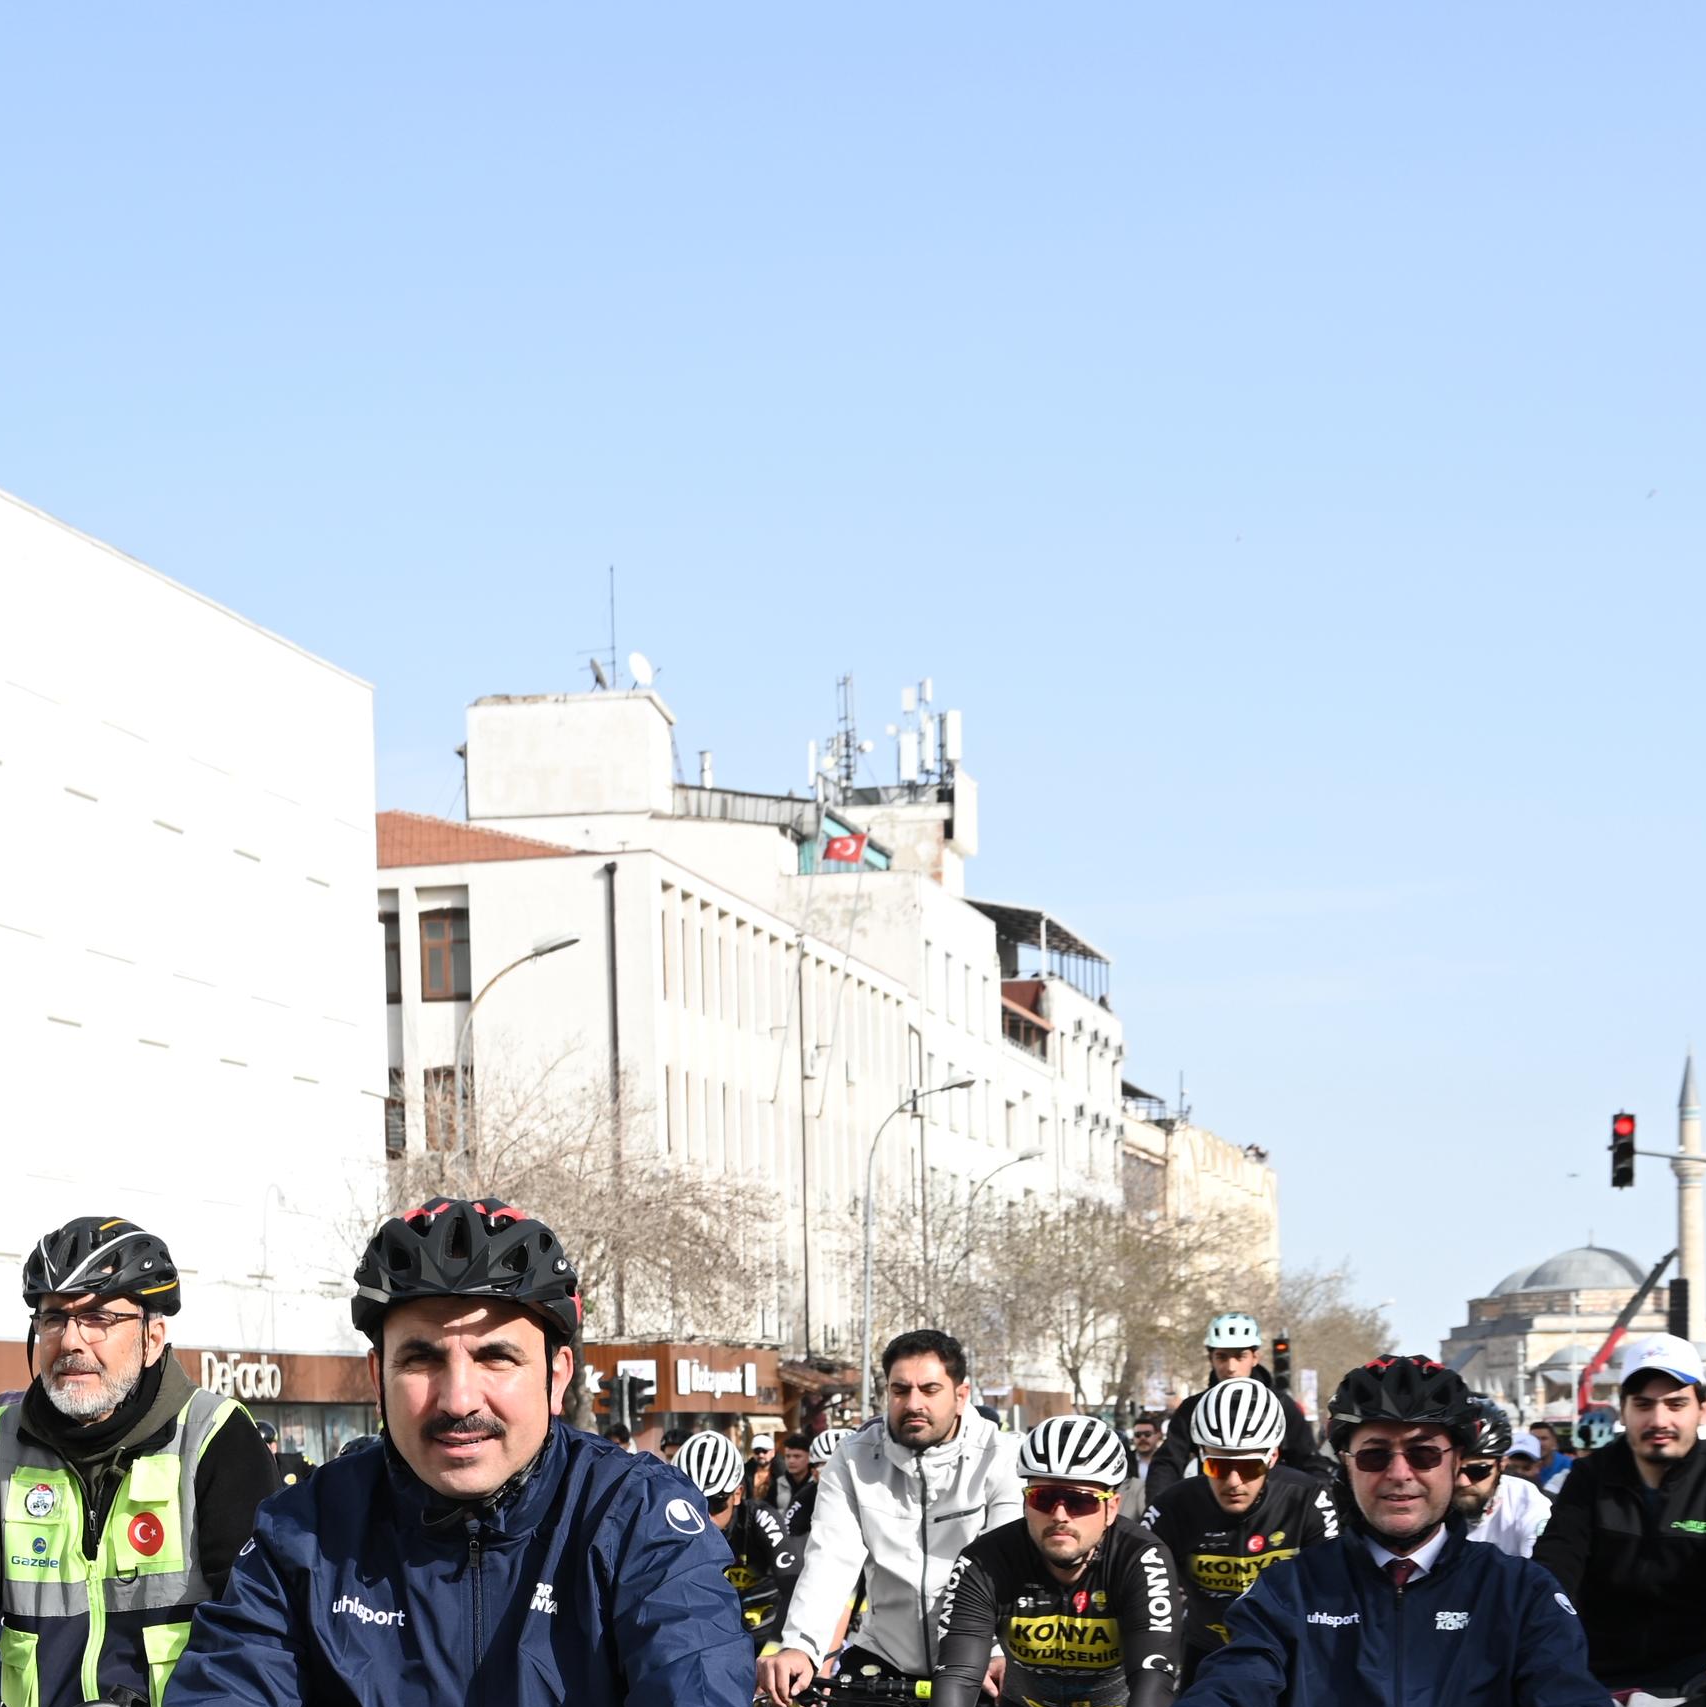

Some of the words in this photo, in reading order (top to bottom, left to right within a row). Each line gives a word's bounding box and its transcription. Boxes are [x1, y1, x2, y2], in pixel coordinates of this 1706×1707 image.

[201, 1351, 282, 1399] DeFacto
[937, 1555, 973, 1642] KONYA
[1139, 1546, 1173, 1633] KONYA
[331, 1594, 406, 1628] uhlsport
[1306, 1611, 1361, 1629] uhlsport
[1014, 1621, 1111, 1647] KONYA
